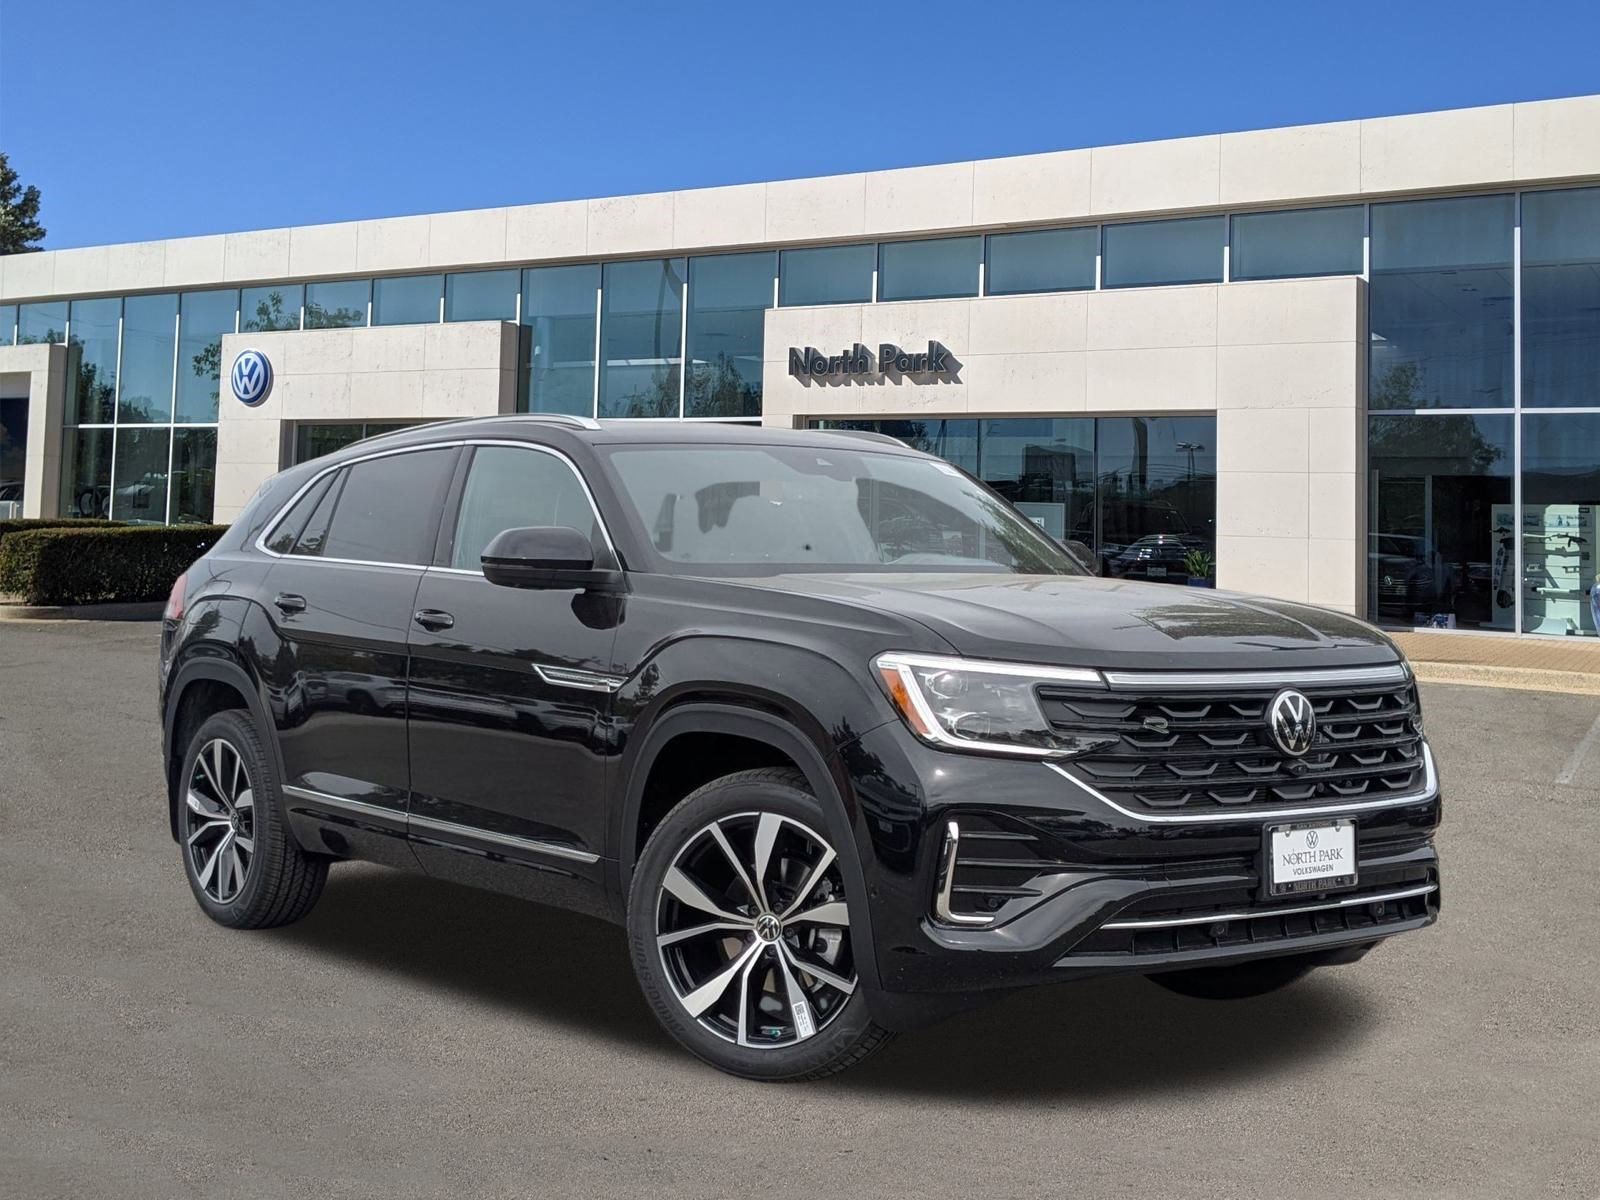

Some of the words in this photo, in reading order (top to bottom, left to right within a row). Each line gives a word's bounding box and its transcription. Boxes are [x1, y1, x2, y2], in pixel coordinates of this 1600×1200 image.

[788, 343, 871, 376] North
[879, 340, 946, 373] Park
[232, 352, 265, 400] VW
[1282, 850, 1316, 866] NORTH
[1319, 848, 1343, 862] PARK
[1293, 864, 1334, 876] VOLKSWAGEN
